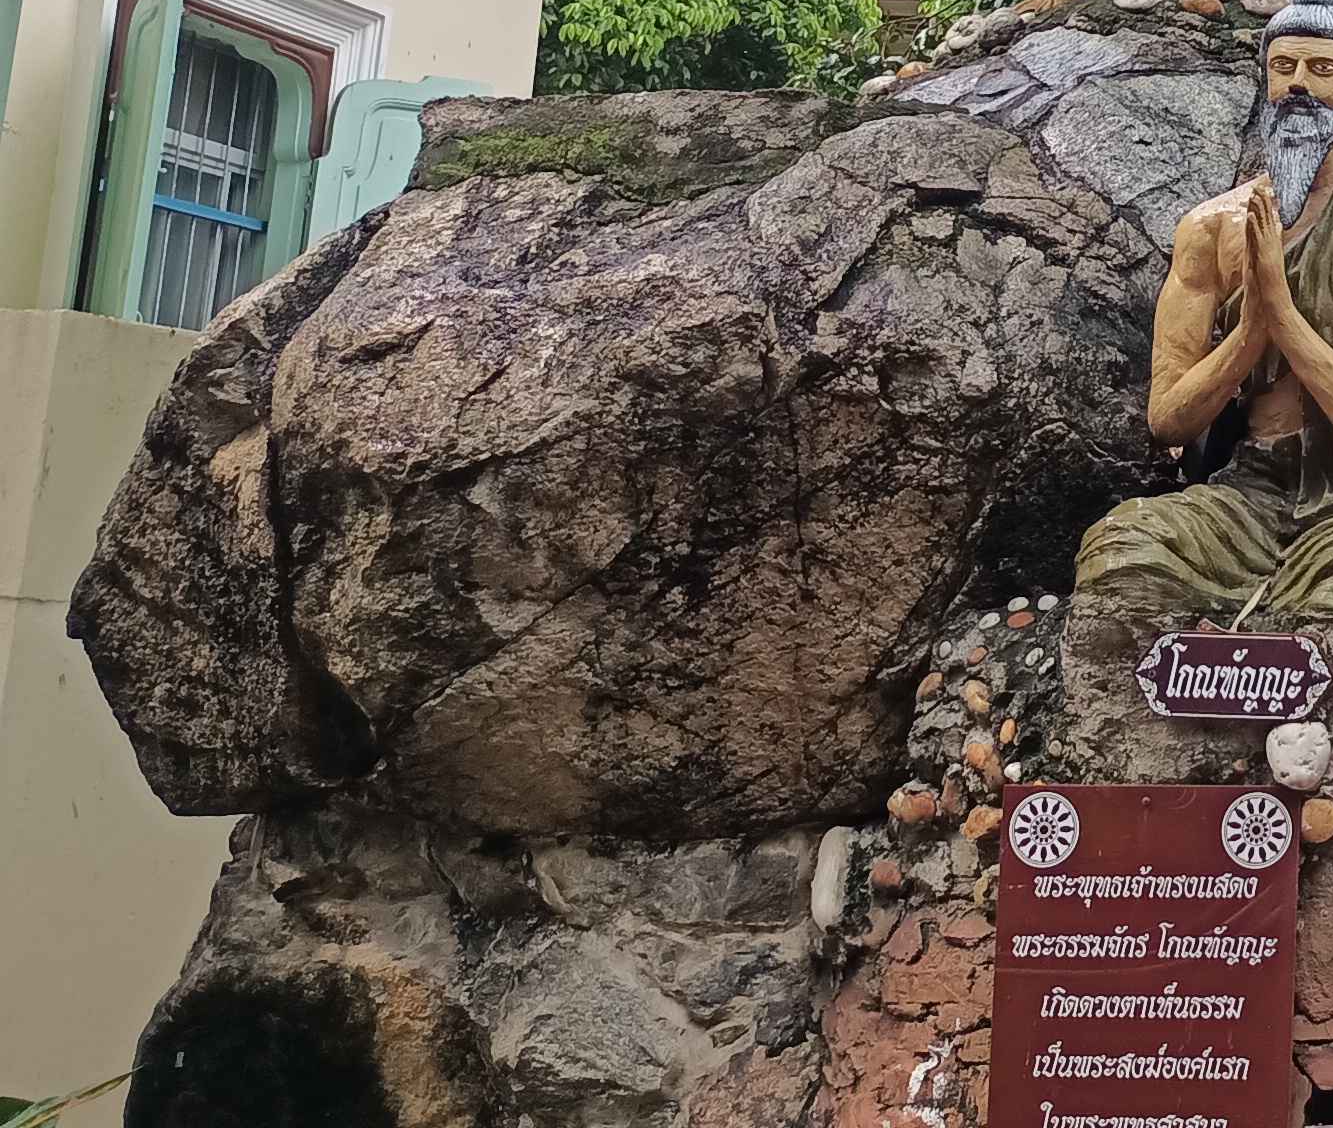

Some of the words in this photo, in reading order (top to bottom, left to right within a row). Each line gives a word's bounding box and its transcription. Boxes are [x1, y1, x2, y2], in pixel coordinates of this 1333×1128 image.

[1165, 643, 1305, 714] โกณฑัญญะ
[1033, 865, 1258, 908] พระพุทธเจ้าทรงแสดง
[1012, 925, 1149, 959] พระธรรมจักร
[1157, 922, 1278, 966] โกณฑัญญะ
[1040, 982, 1246, 1020] เกิดดวงตาเห็นธรรม
[1032, 1040, 1250, 1082] เป็นพระสงฆ์องค์แรก
